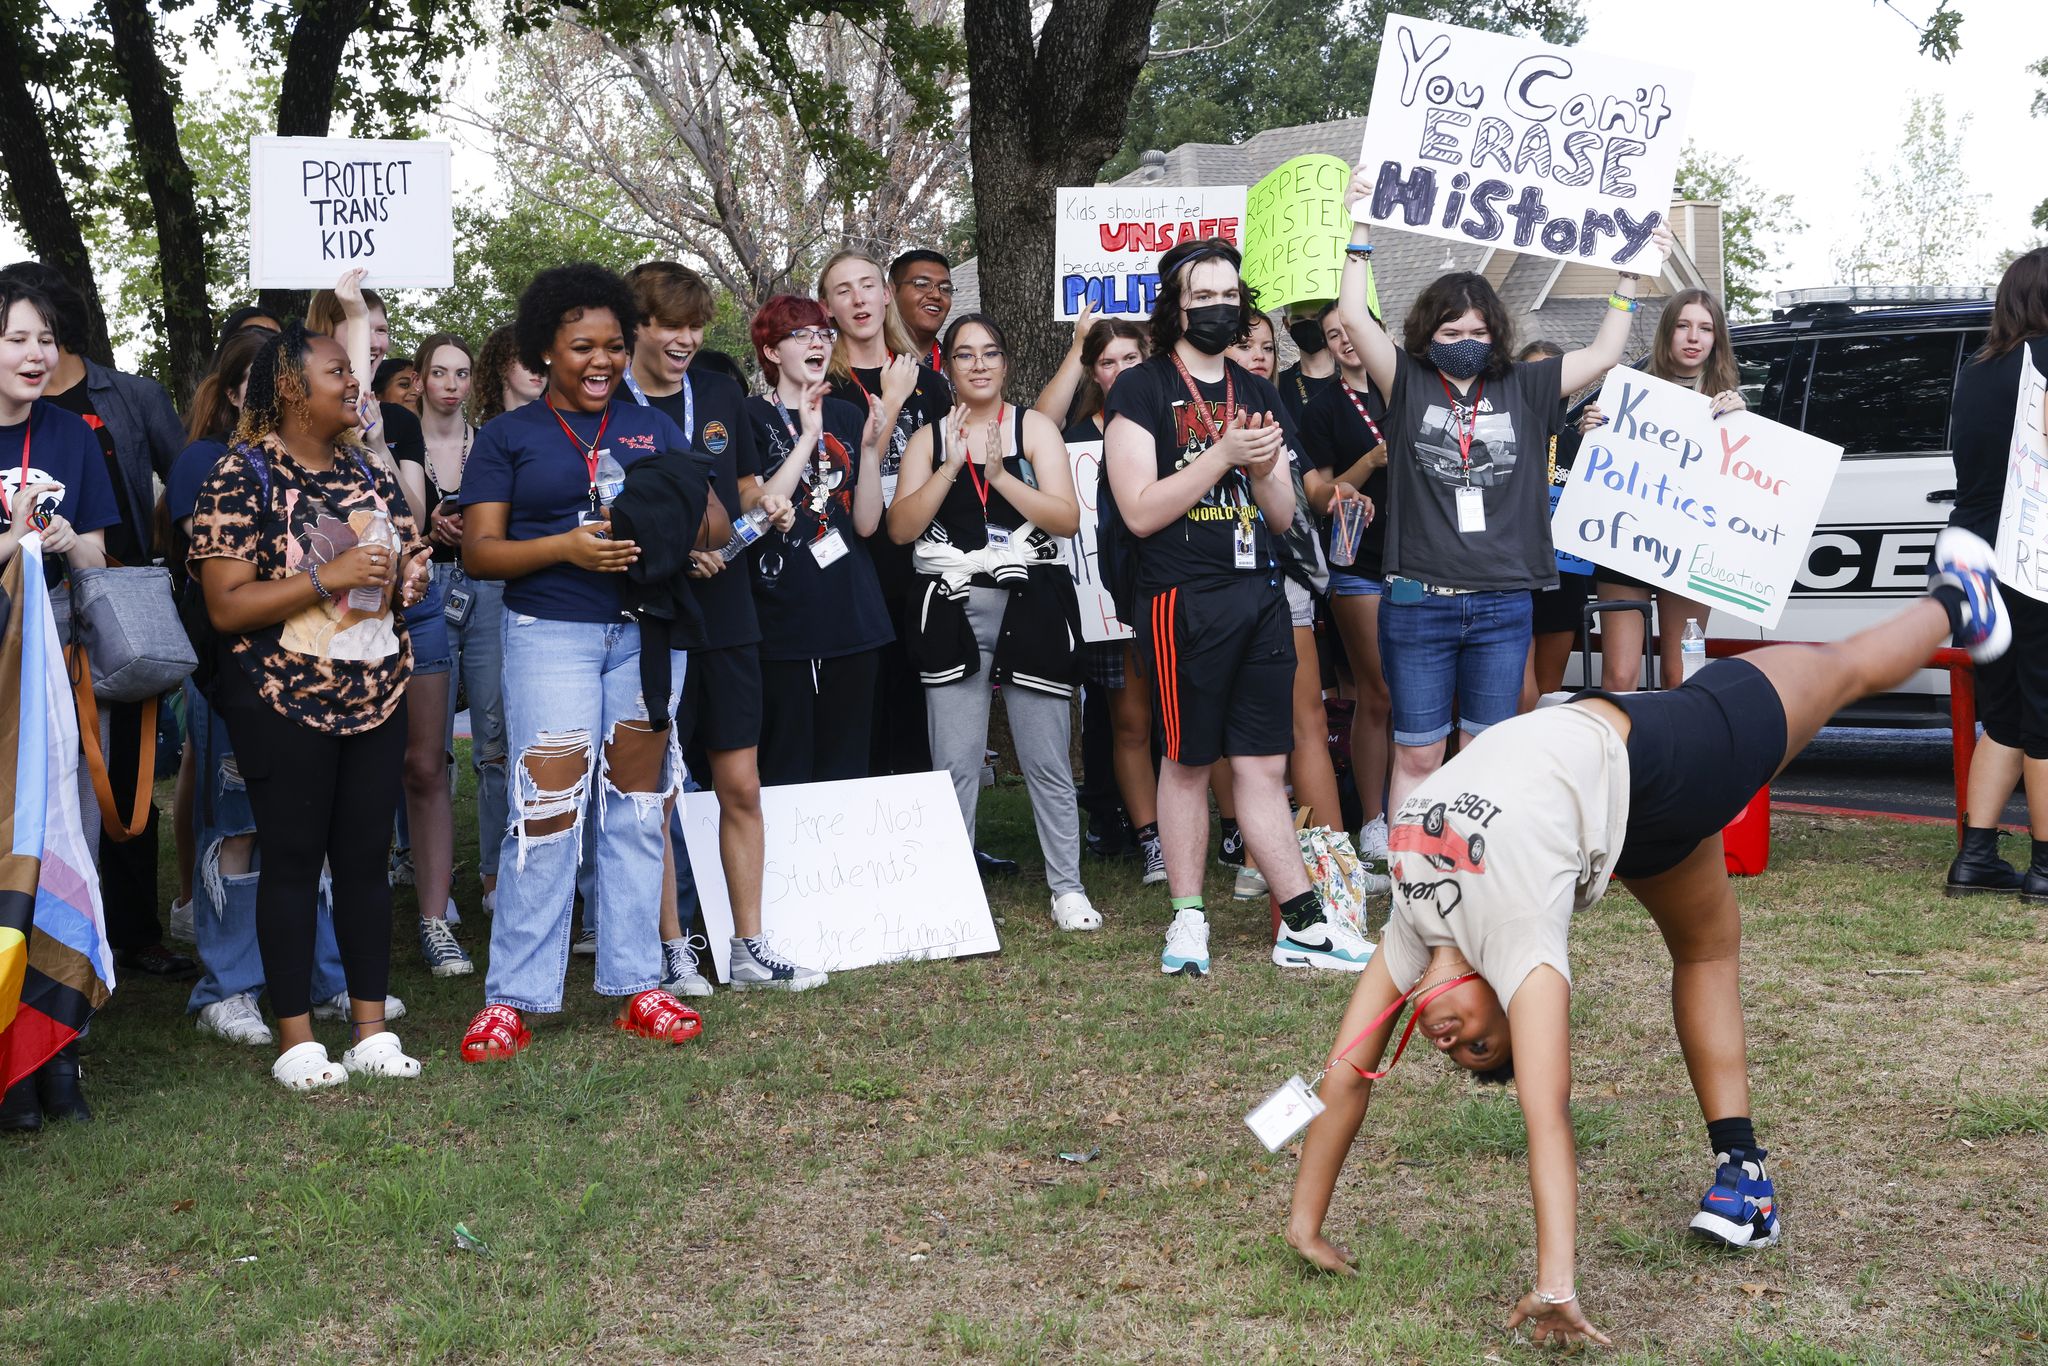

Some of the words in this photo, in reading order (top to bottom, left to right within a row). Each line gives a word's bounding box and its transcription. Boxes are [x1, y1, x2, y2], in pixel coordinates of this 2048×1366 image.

[1398, 26, 1484, 109] You
[1504, 54, 1672, 139] Can't
[1418, 107, 1646, 198] ERASE
[302, 160, 412, 198] PROTECT
[1247, 163, 1346, 226] RESPECT
[310, 197, 388, 226] TRANS
[1066, 195, 1097, 221] Kids
[1175, 193, 1204, 218] feel
[1244, 198, 1353, 258] EXISTEN
[322, 228, 375, 260] KIDS
[1099, 217, 1238, 253] UNSAFE
[1063, 252, 1128, 274] because
[1135, 256, 1150, 271] of
[1062, 273, 1162, 316] POLIT
[1257, 268, 1343, 310] ESIST
[1613, 382, 1703, 469] Keep
[1719, 427, 1792, 496] Your
[1188, 506, 1233, 521] WORLD
[1583, 444, 1717, 528] Politics
[1728, 515, 1786, 546] out
[1578, 511, 1640, 549] of
[1632, 534, 1682, 579] my
[1688, 543, 1776, 597] Education
[790, 807, 845, 844] Are
[866, 799, 929, 836] Not
[1448, 793, 1502, 829] 1965
[873, 912, 978, 947] Human
